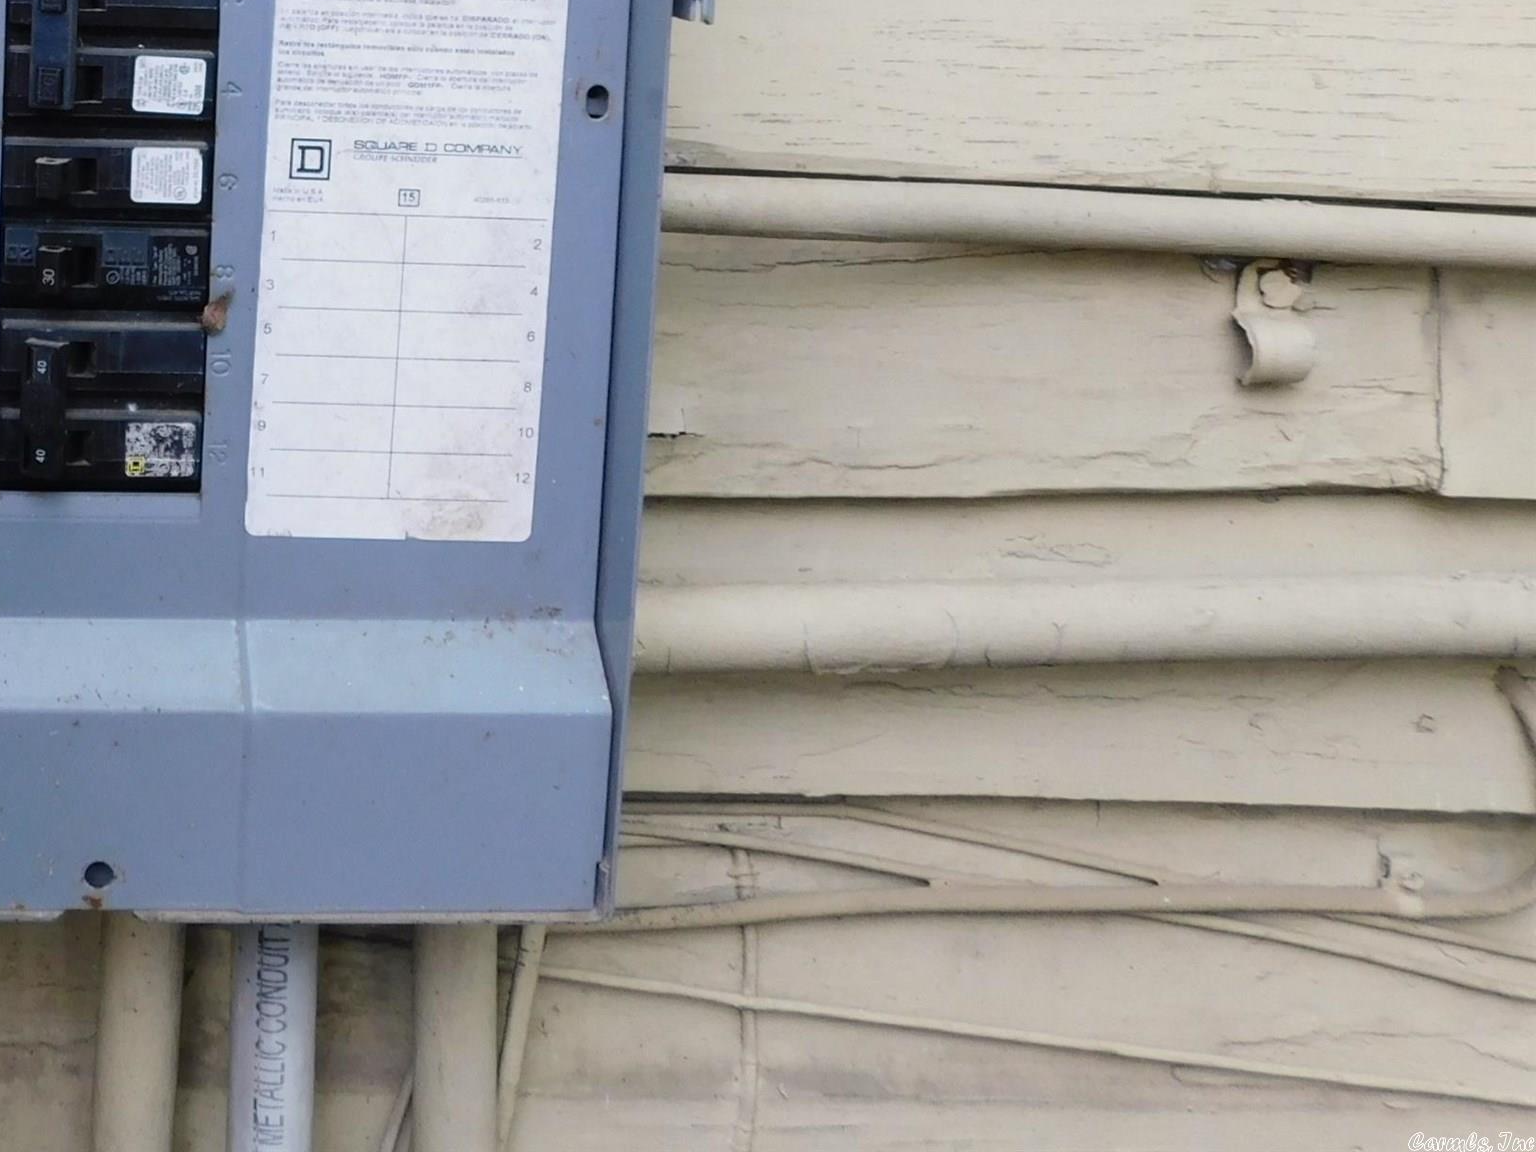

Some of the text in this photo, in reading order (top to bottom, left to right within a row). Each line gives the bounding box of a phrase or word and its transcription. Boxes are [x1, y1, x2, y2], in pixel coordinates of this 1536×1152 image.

[353, 139, 523, 156] SQUARE D COMPANY
[402, 192, 416, 203] 15
[270, 230, 276, 242] 1
[533, 239, 542, 250] 2
[42, 268, 55, 286] 30
[266, 279, 274, 290] 3
[529, 286, 538, 297] 4
[264, 323, 272, 334] 5
[526, 331, 535, 342] 6
[36, 360, 47, 375] 40
[261, 373, 269, 384] 7
[523, 382, 532, 393] 8
[257, 420, 266, 431] 9
[518, 427, 534, 439] 10
[35, 448, 46, 464] 40
[250, 466, 266, 478] 11
[514, 472, 530, 484] 12
[253, 927, 292, 1147] METALLIC CONDUIT
